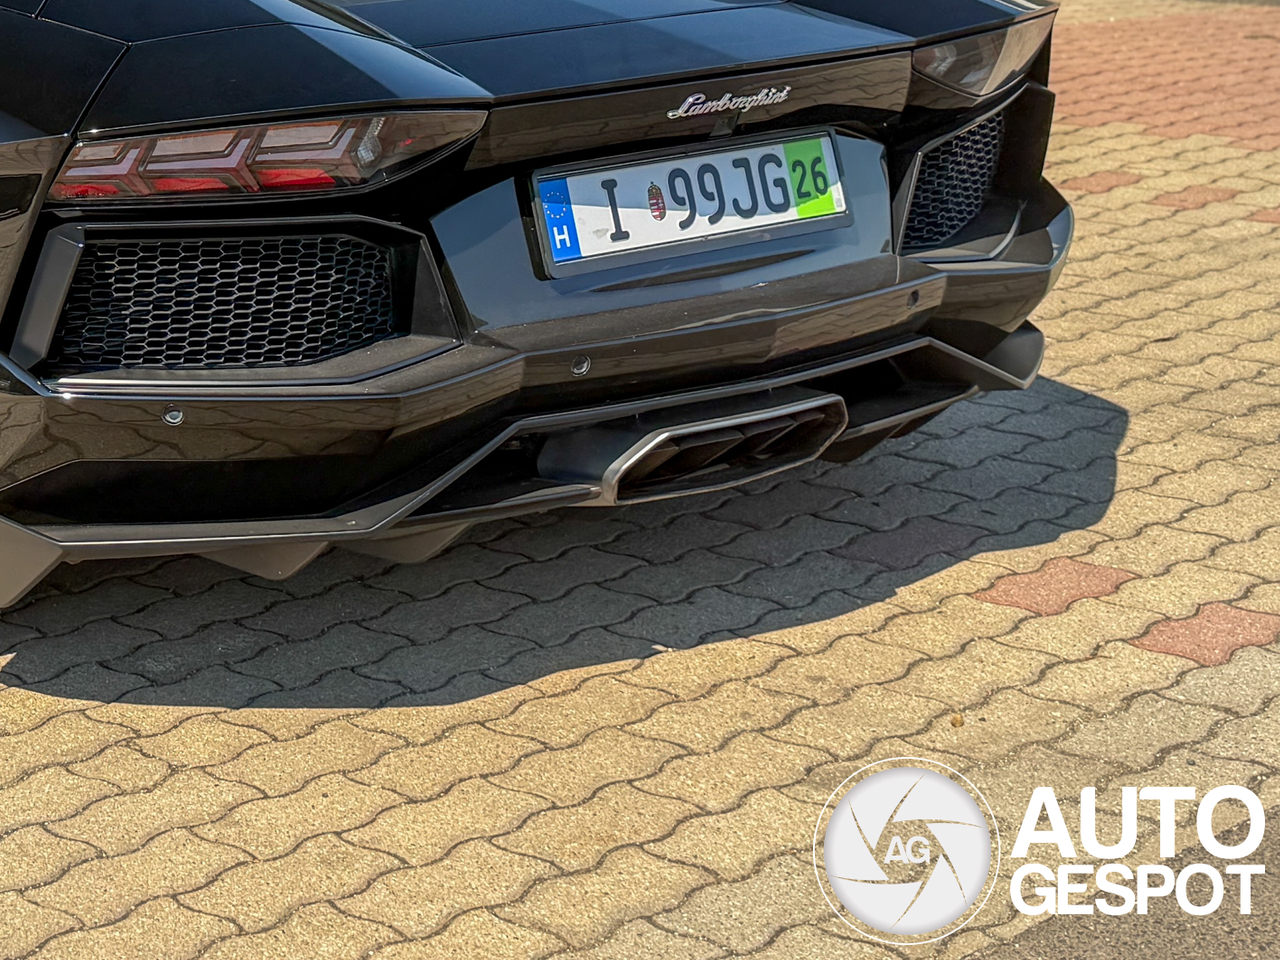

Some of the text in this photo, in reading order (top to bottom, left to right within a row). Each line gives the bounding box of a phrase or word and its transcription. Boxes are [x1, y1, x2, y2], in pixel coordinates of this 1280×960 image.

[666, 86, 791, 119] Lamborghini
[791, 156, 829, 199] 26
[553, 226, 571, 249] H
